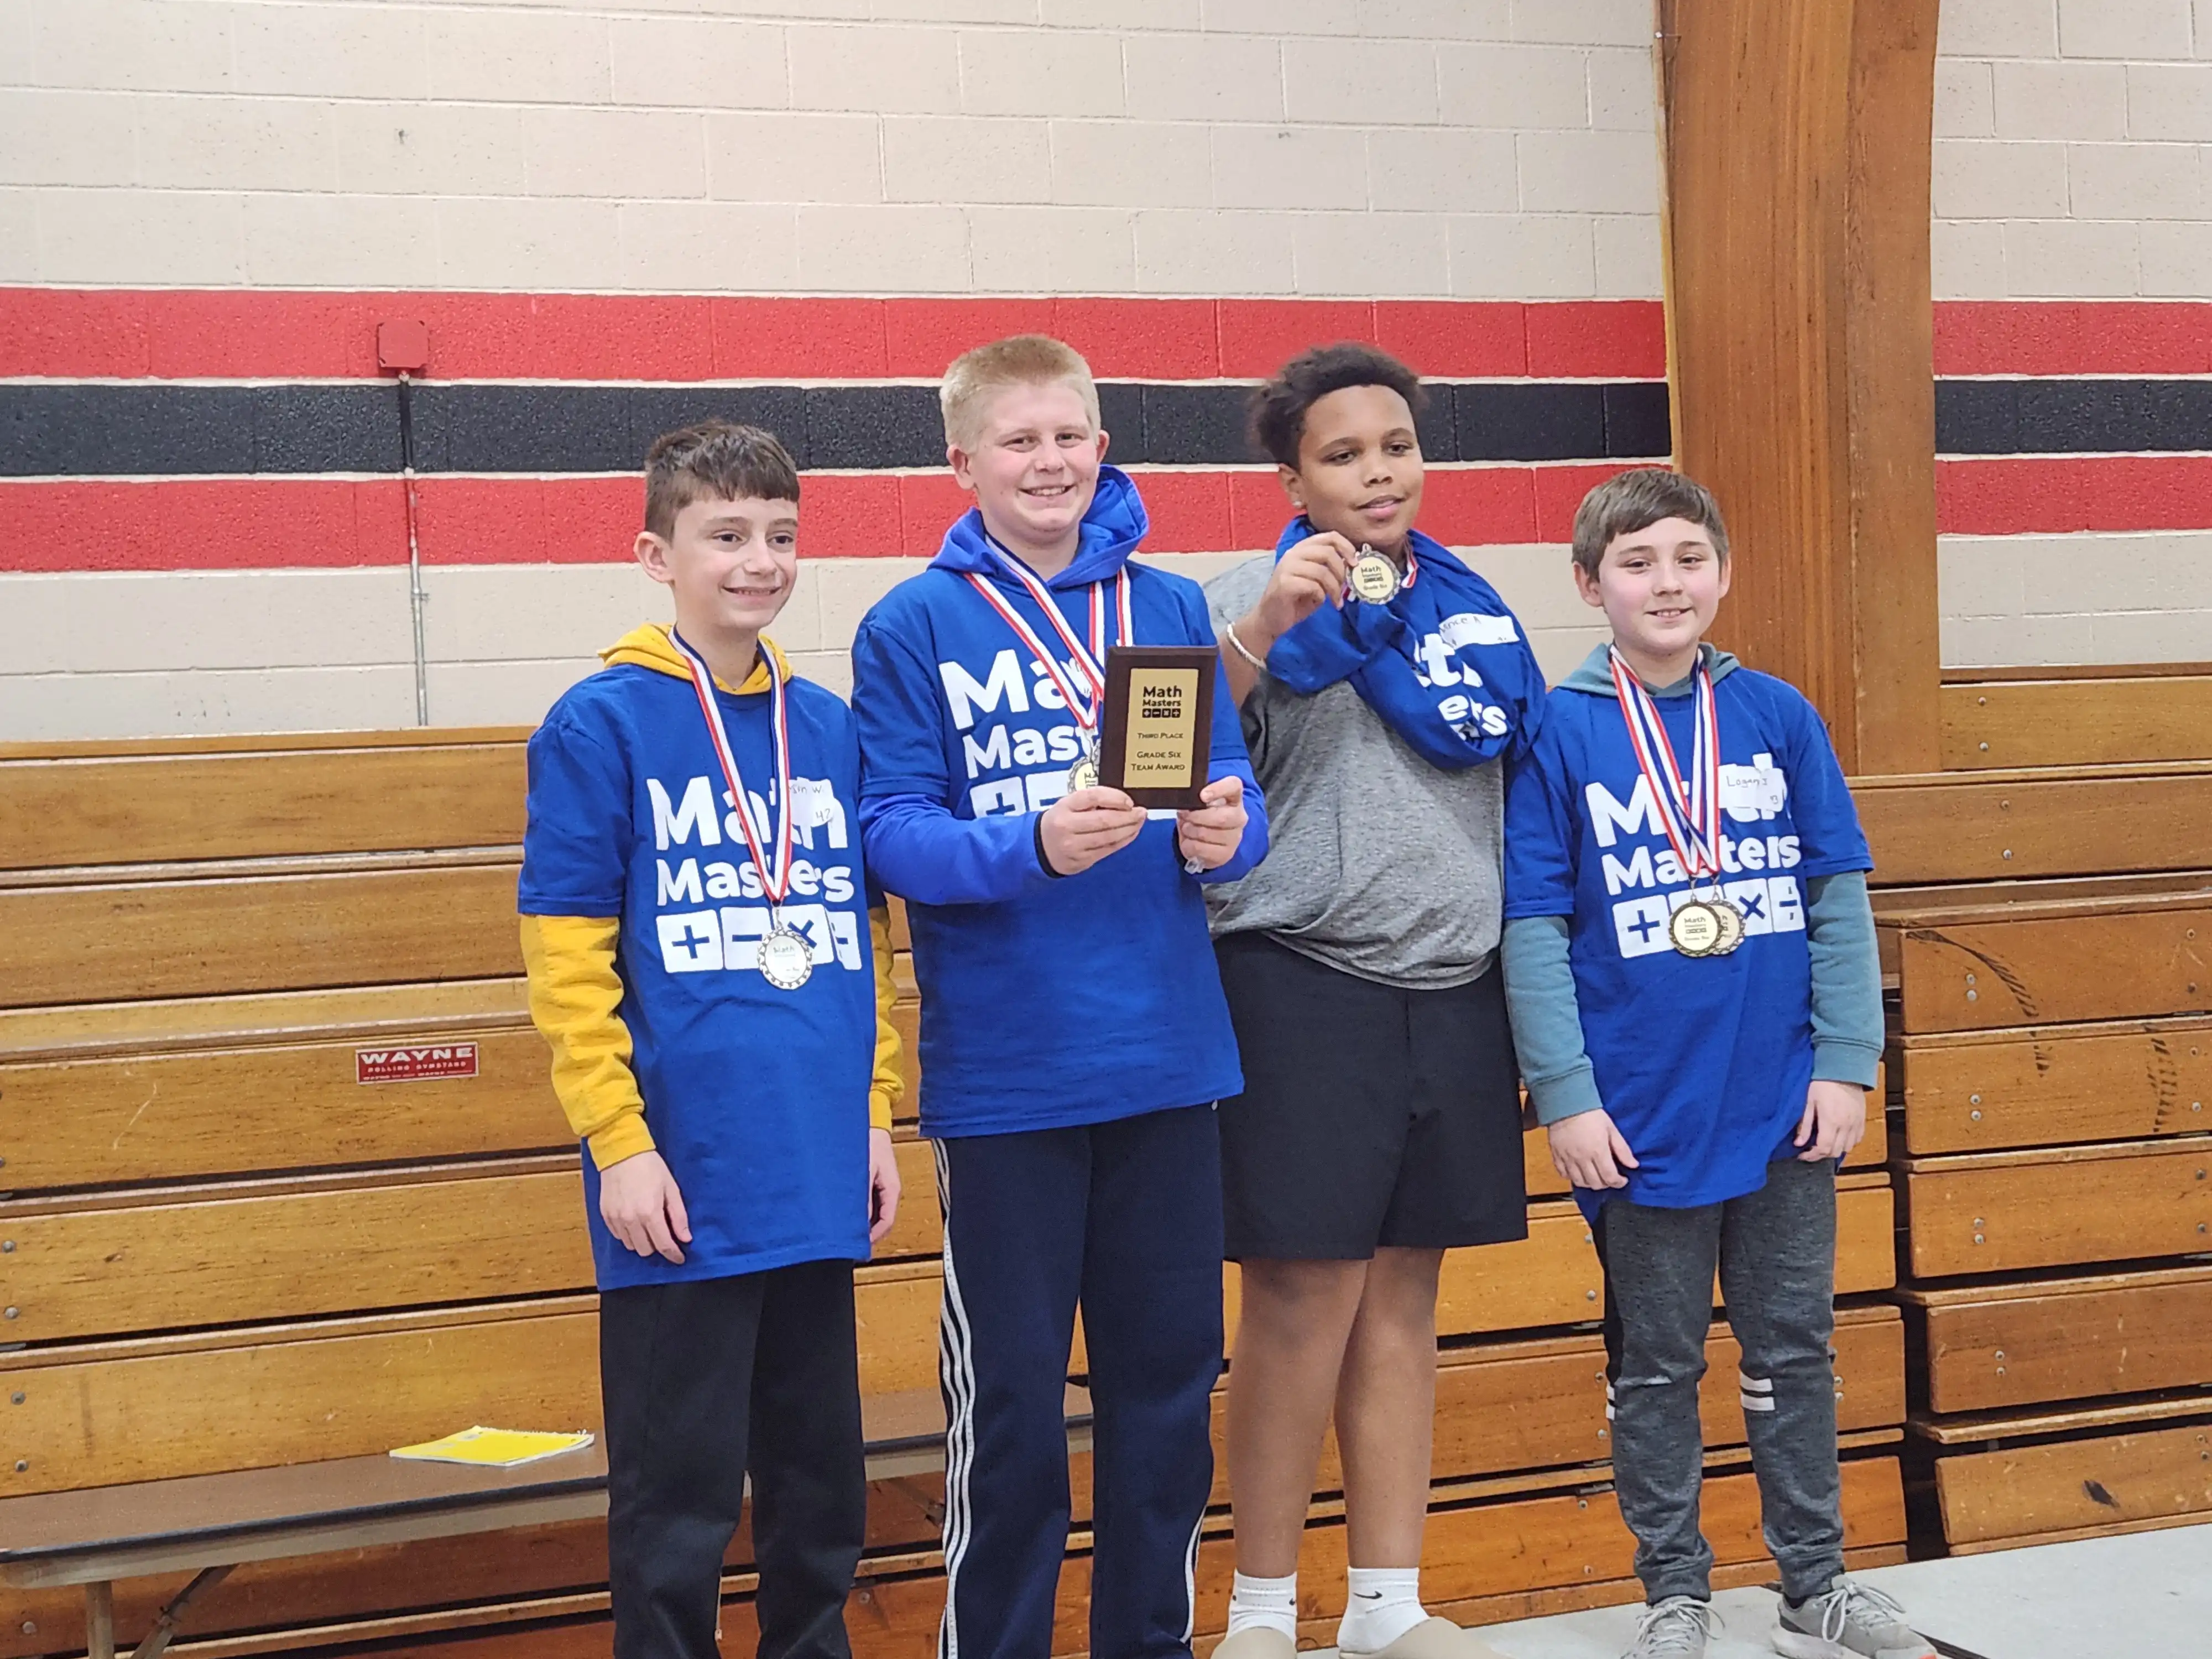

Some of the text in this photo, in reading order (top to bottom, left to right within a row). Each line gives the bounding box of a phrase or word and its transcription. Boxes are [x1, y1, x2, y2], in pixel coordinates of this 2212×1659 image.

[1360, 565, 1381, 574] Math
[1142, 685, 1182, 698] Math
[962, 724, 1102, 779] Mast
[1601, 835, 1801, 896] Maters
[360, 1047, 473, 1065] WAYNE
